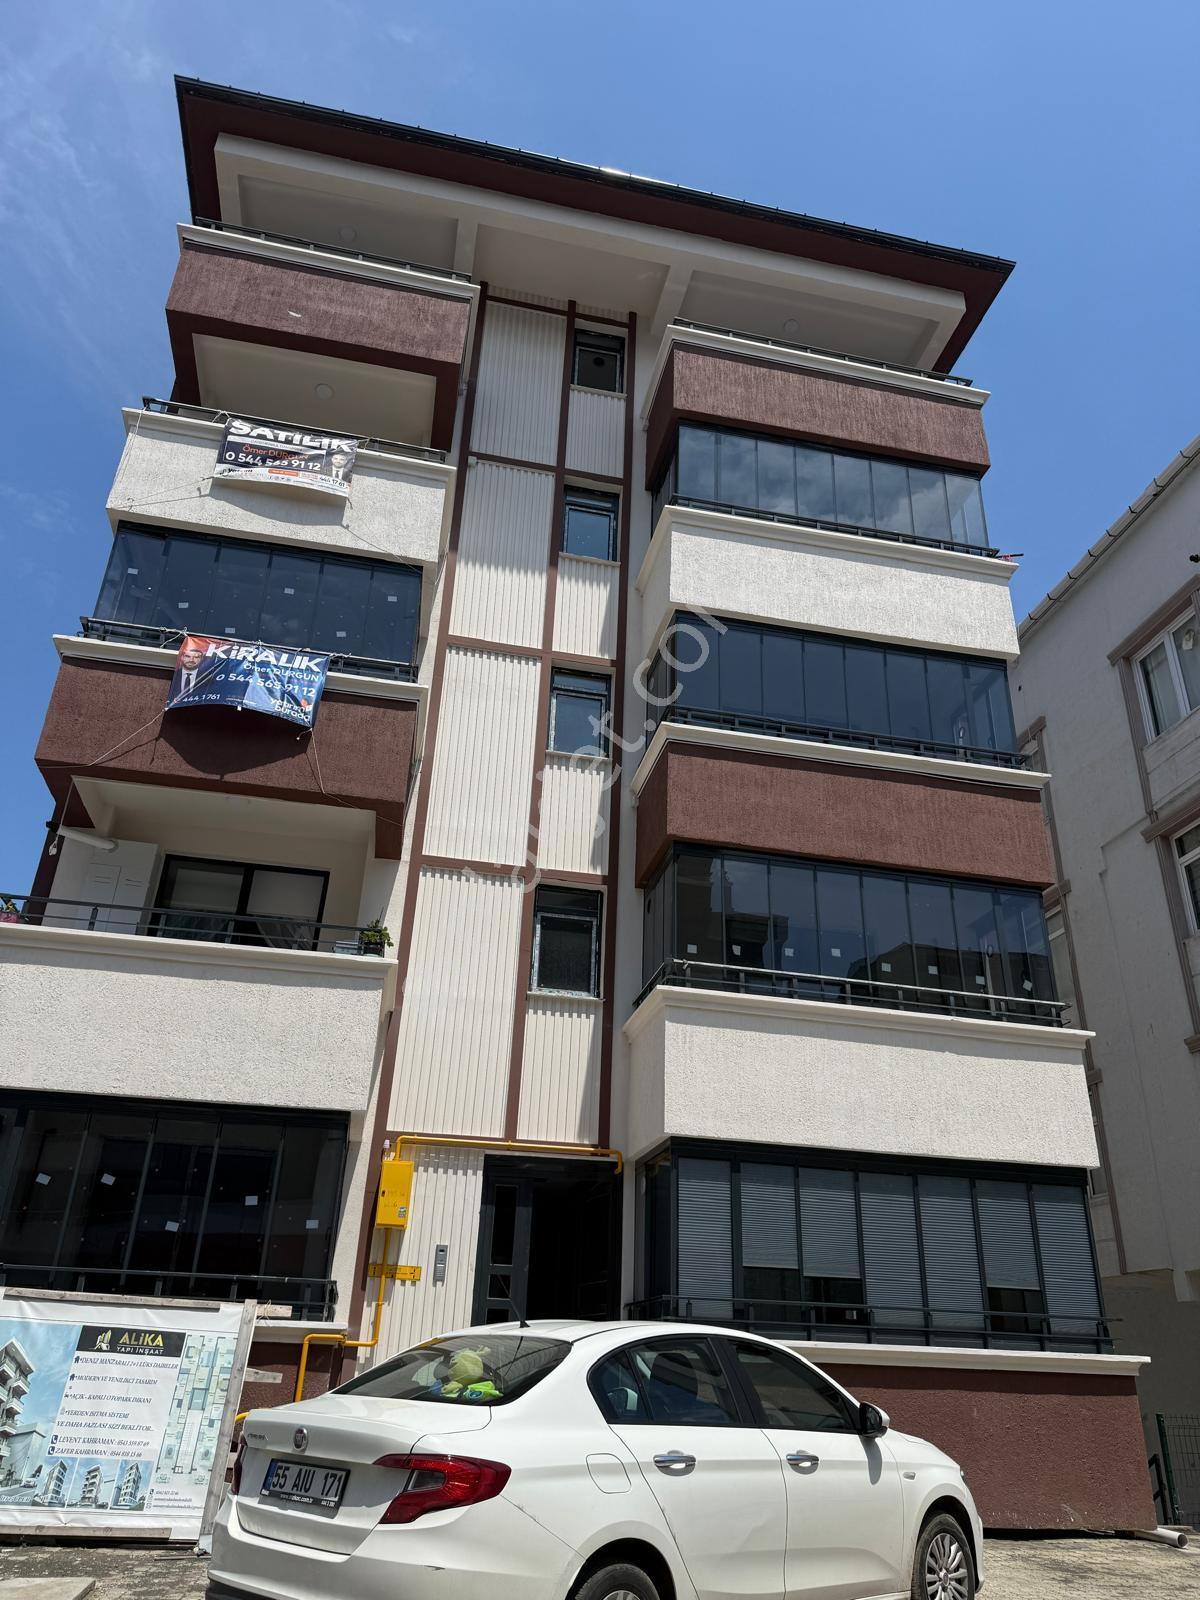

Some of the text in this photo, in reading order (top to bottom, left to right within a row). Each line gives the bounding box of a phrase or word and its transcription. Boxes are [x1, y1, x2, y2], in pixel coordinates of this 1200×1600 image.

[229, 420, 355, 452] SATILIK
[242, 444, 266, 455] Ömer
[225, 452, 235, 461] 0
[238, 453, 262, 466] 544
[291, 459, 305, 468] 91
[308, 462, 320, 471] 12
[243, 662, 319, 681] Ömer DURGUN
[228, 673, 253, 684] 544
[257, 679, 281, 689] 565
[285, 683, 299, 693] 91
[302, 687, 316, 697] 12
[136, 1346, 164, 1355] İNŞAAT
[82, 1437, 115, 1445] KAHRAMAN
[55, 1447, 74, 1455] ZAFER
[74, 1448, 107, 1456] KAHRAMAN
[272, 1464, 343, 1499] 55 AIU 171
